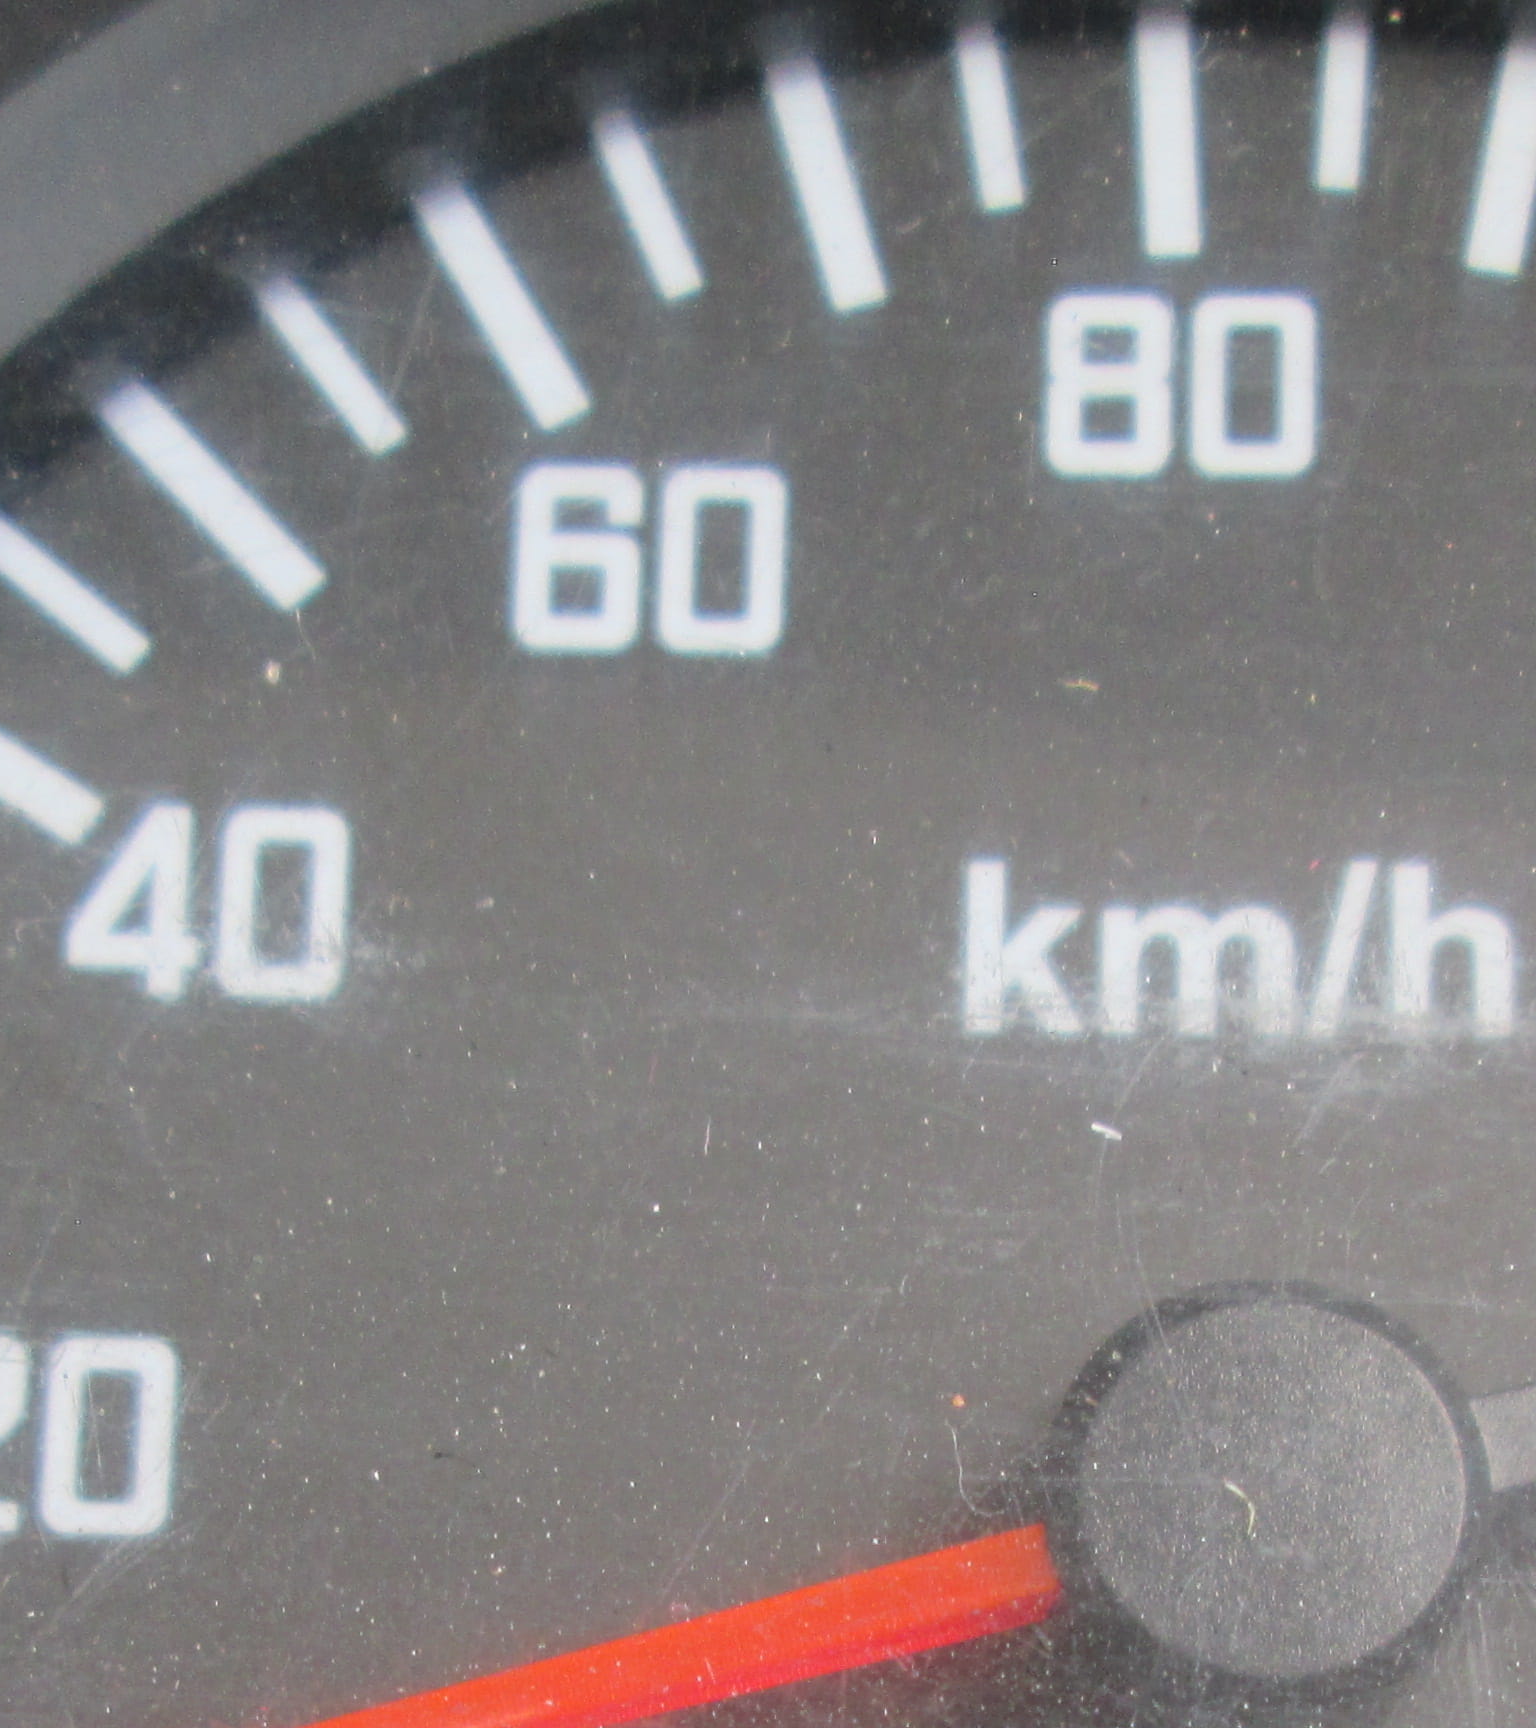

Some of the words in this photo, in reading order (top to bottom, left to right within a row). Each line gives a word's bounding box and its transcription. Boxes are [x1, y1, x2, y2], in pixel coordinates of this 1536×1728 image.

[1041, 288, 1319, 478] 80
[509, 462, 788, 655] 60
[64, 801, 351, 1003] 40
[960, 855, 1519, 1038] km/h
